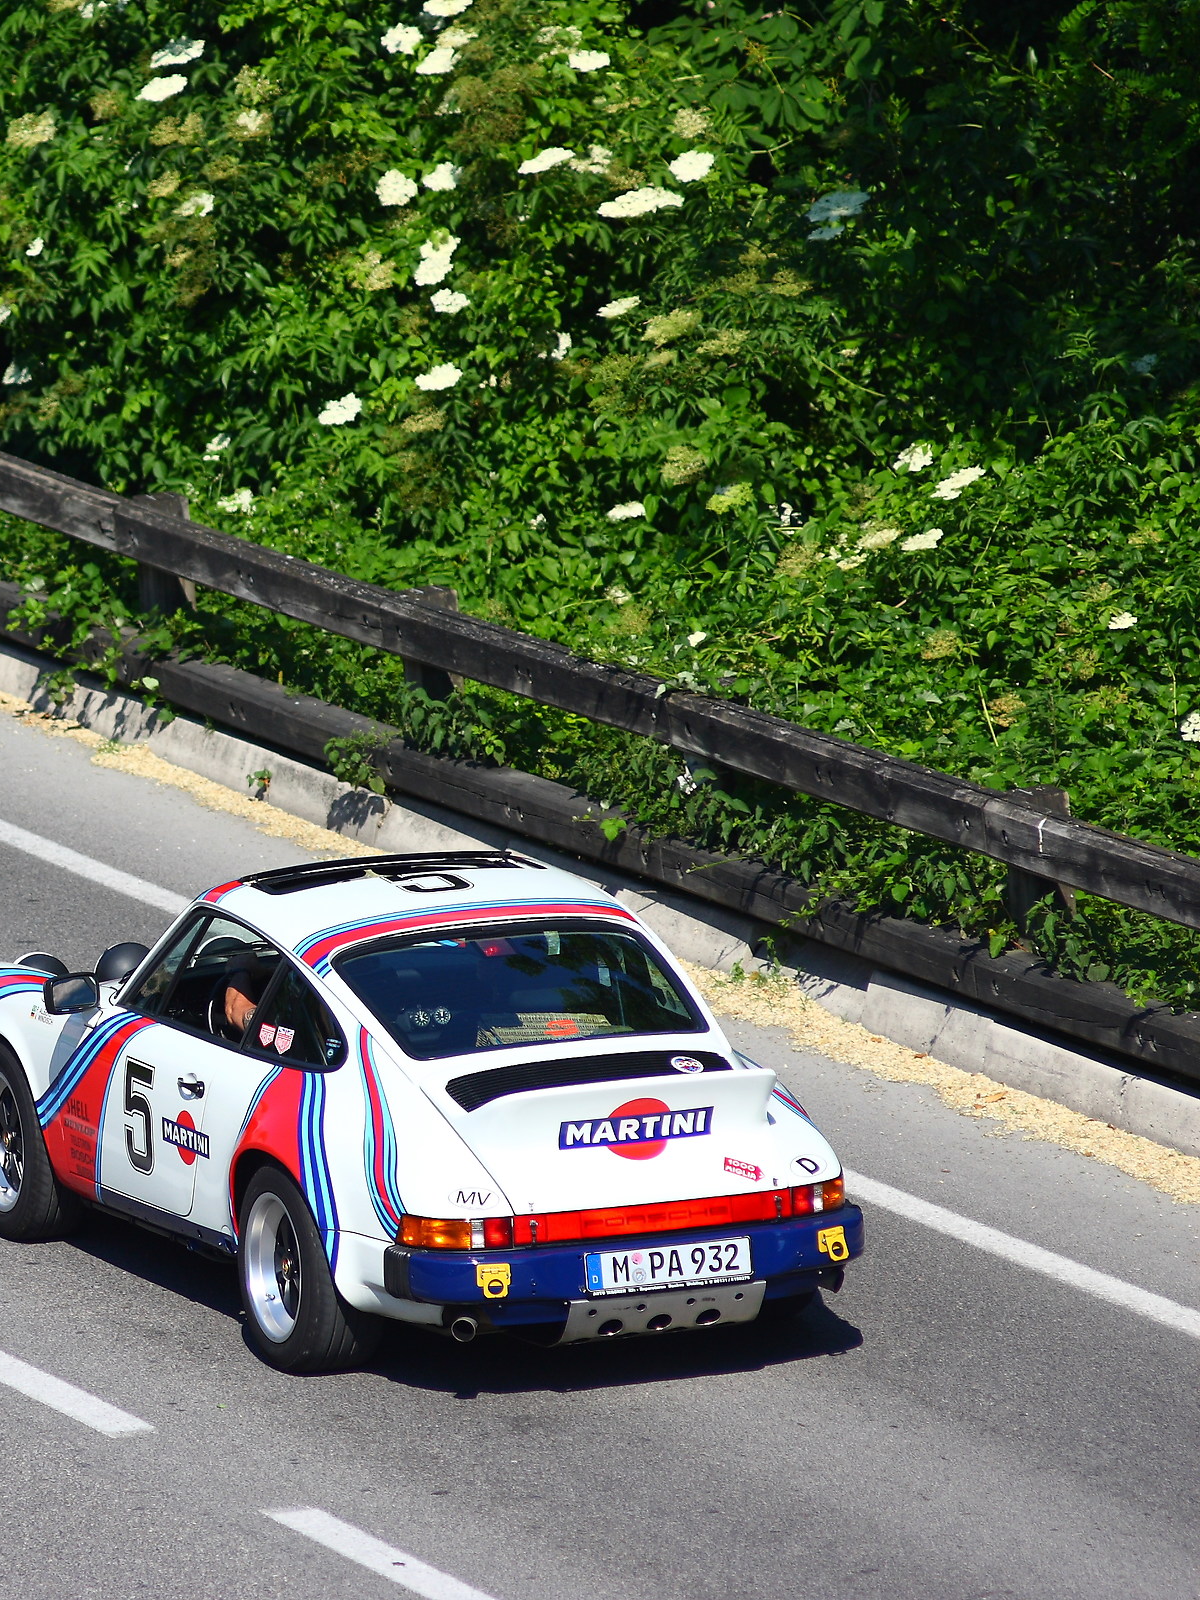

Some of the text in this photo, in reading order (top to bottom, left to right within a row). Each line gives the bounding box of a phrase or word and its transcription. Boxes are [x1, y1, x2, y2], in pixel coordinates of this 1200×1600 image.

[123, 1055, 155, 1176] 5
[563, 1110, 708, 1147] MARTINI
[163, 1120, 209, 1156] MARTINI
[725, 1165, 757, 1181] MIGLIA
[727, 1159, 756, 1172] 1000
[796, 1157, 821, 1175] D
[456, 1190, 492, 1206] MV
[612, 1244, 740, 1284] M PA 932
[592, 1275, 599, 1284] D
